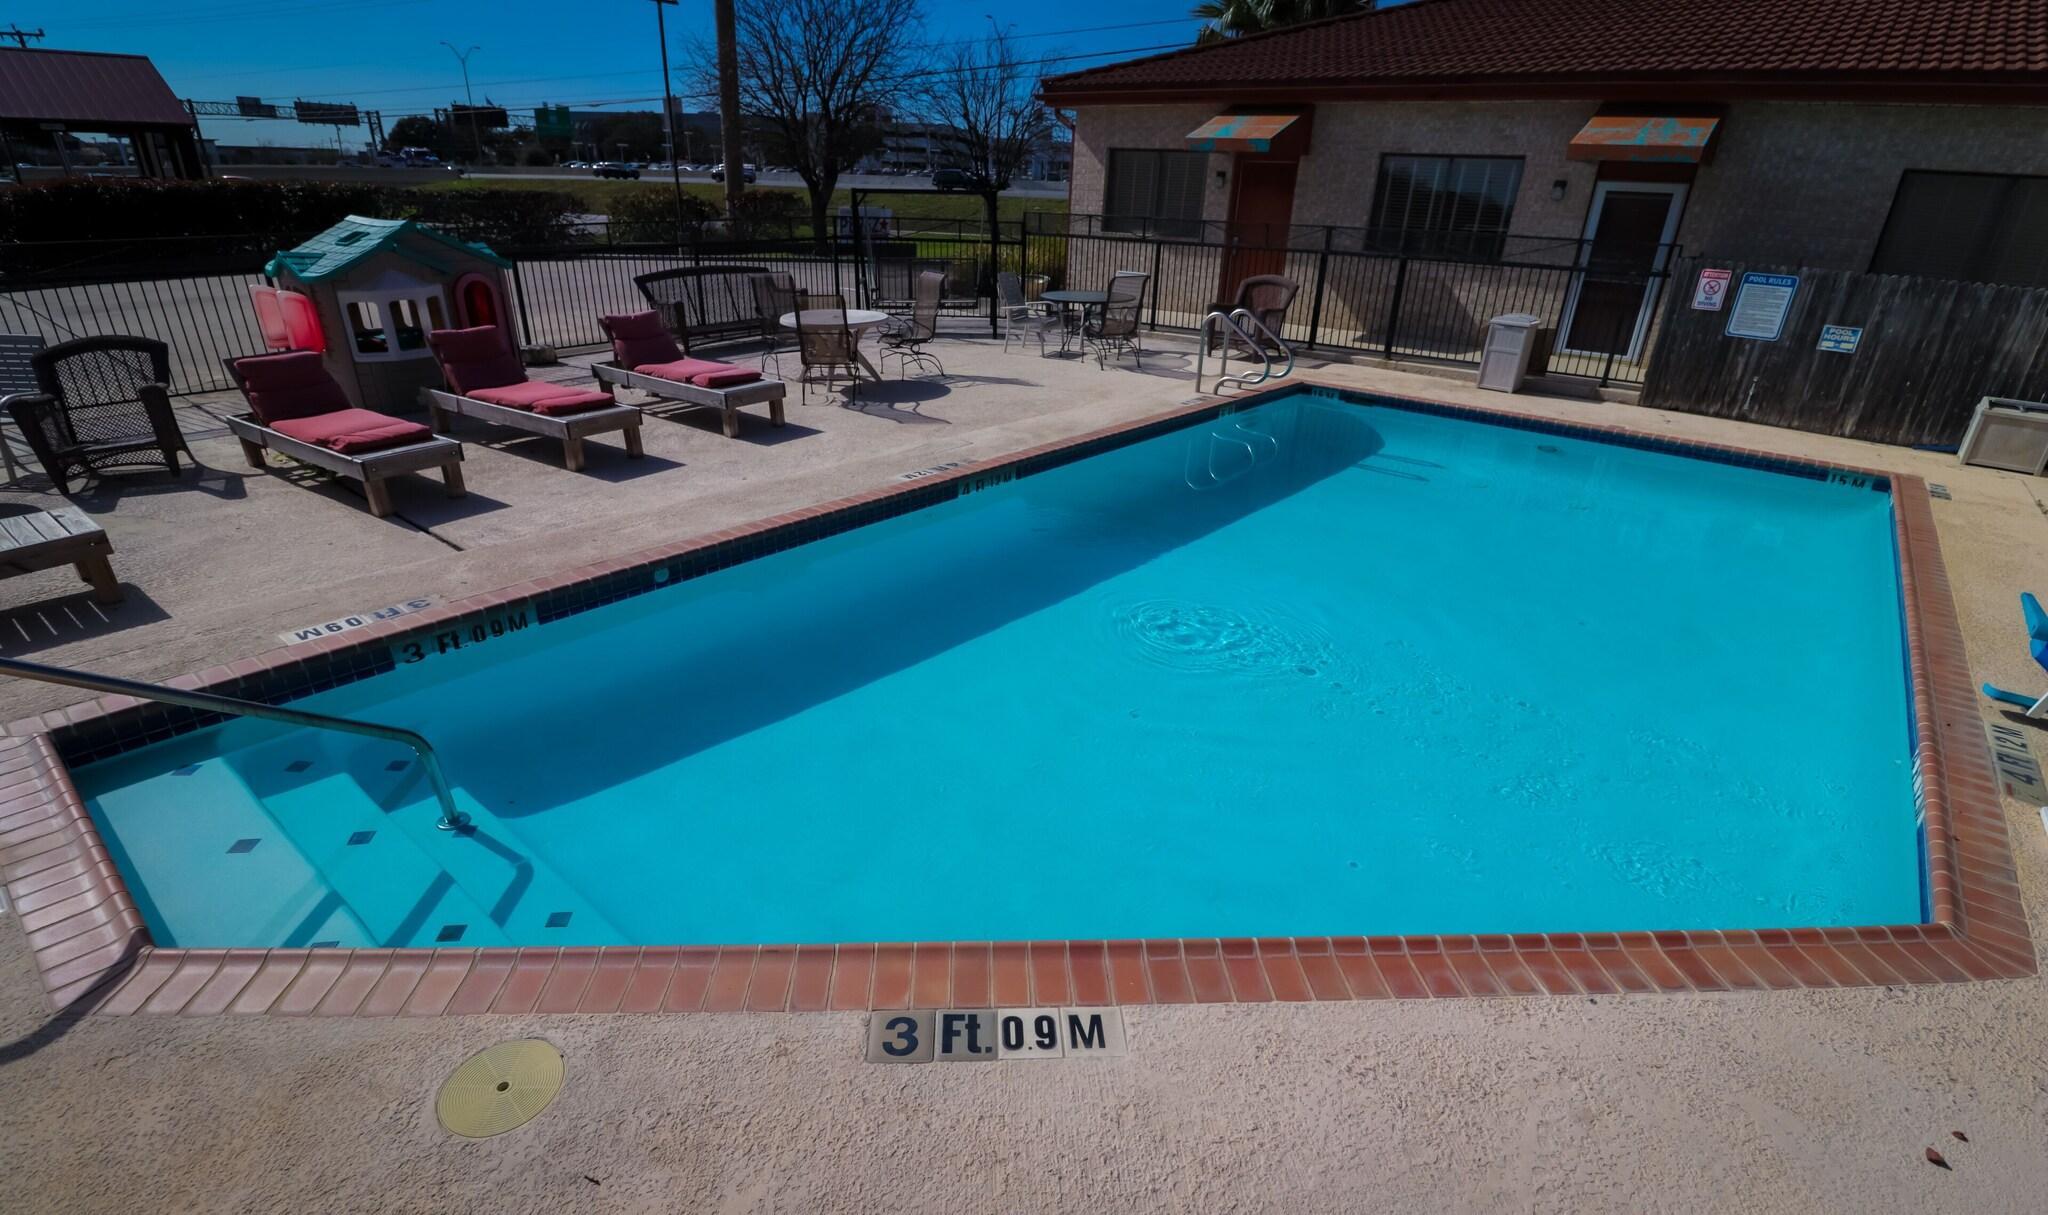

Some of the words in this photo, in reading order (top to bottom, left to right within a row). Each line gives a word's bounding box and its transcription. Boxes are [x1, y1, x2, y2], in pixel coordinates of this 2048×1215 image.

[1748, 275, 1767, 283] POOL
[1768, 277, 1792, 286] RULES
[1824, 334, 1855, 342] HOURS
[1829, 328, 1853, 336] POOL
[407, 599, 432, 610] 3
[294, 627, 323, 641] M
[402, 642, 426, 664] 3
[507, 611, 529, 633] M
[2001, 768, 2039, 786] 4
[882, 1016, 919, 1057] 3
[941, 1013, 993, 1055] Ft.
[1001, 1015, 1058, 1051] 0.9
[1067, 1014, 1106, 1050] M
